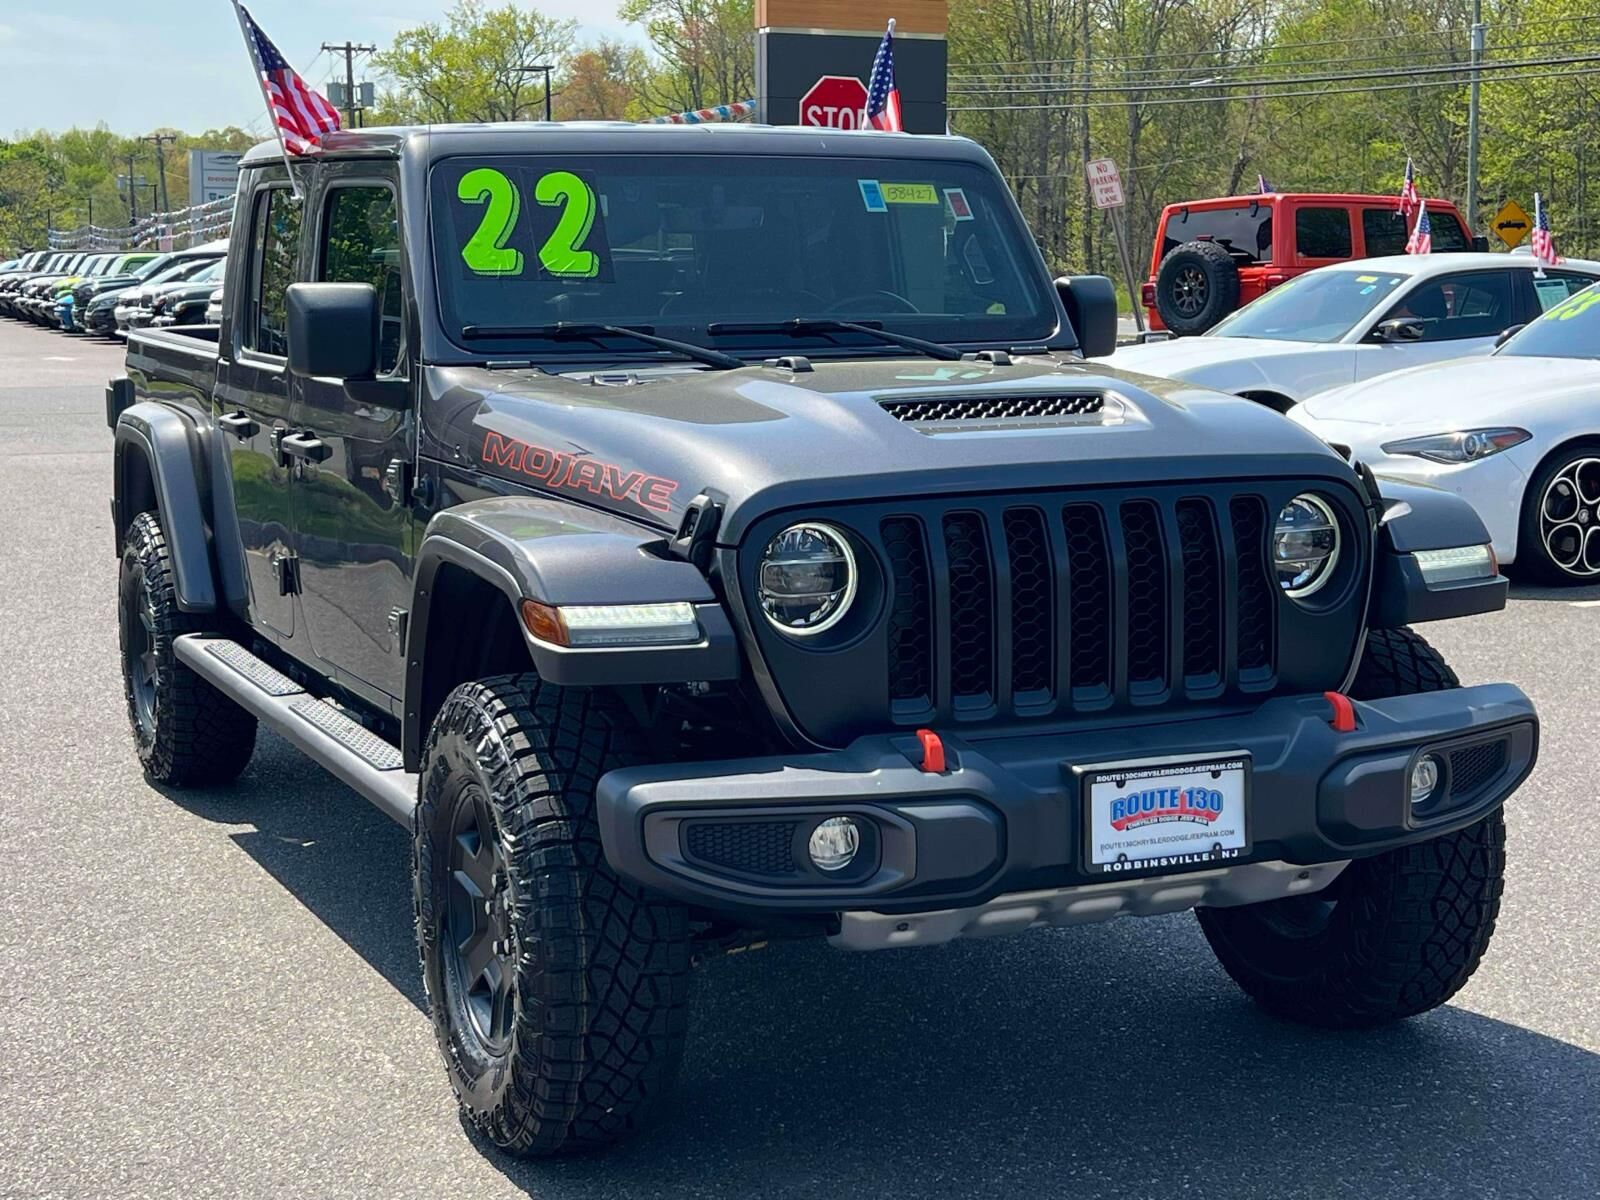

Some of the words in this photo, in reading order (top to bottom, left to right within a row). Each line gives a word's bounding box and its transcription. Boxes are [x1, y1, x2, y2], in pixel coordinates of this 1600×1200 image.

[1096, 162, 1108, 173] NO
[1090, 174, 1119, 185] PARKING
[457, 167, 600, 278] 22
[483, 432, 679, 512] MOJAVE
[1110, 787, 1181, 821] ROUTE
[1184, 787, 1223, 813] 130
[1222, 849, 1239, 858] NJ
